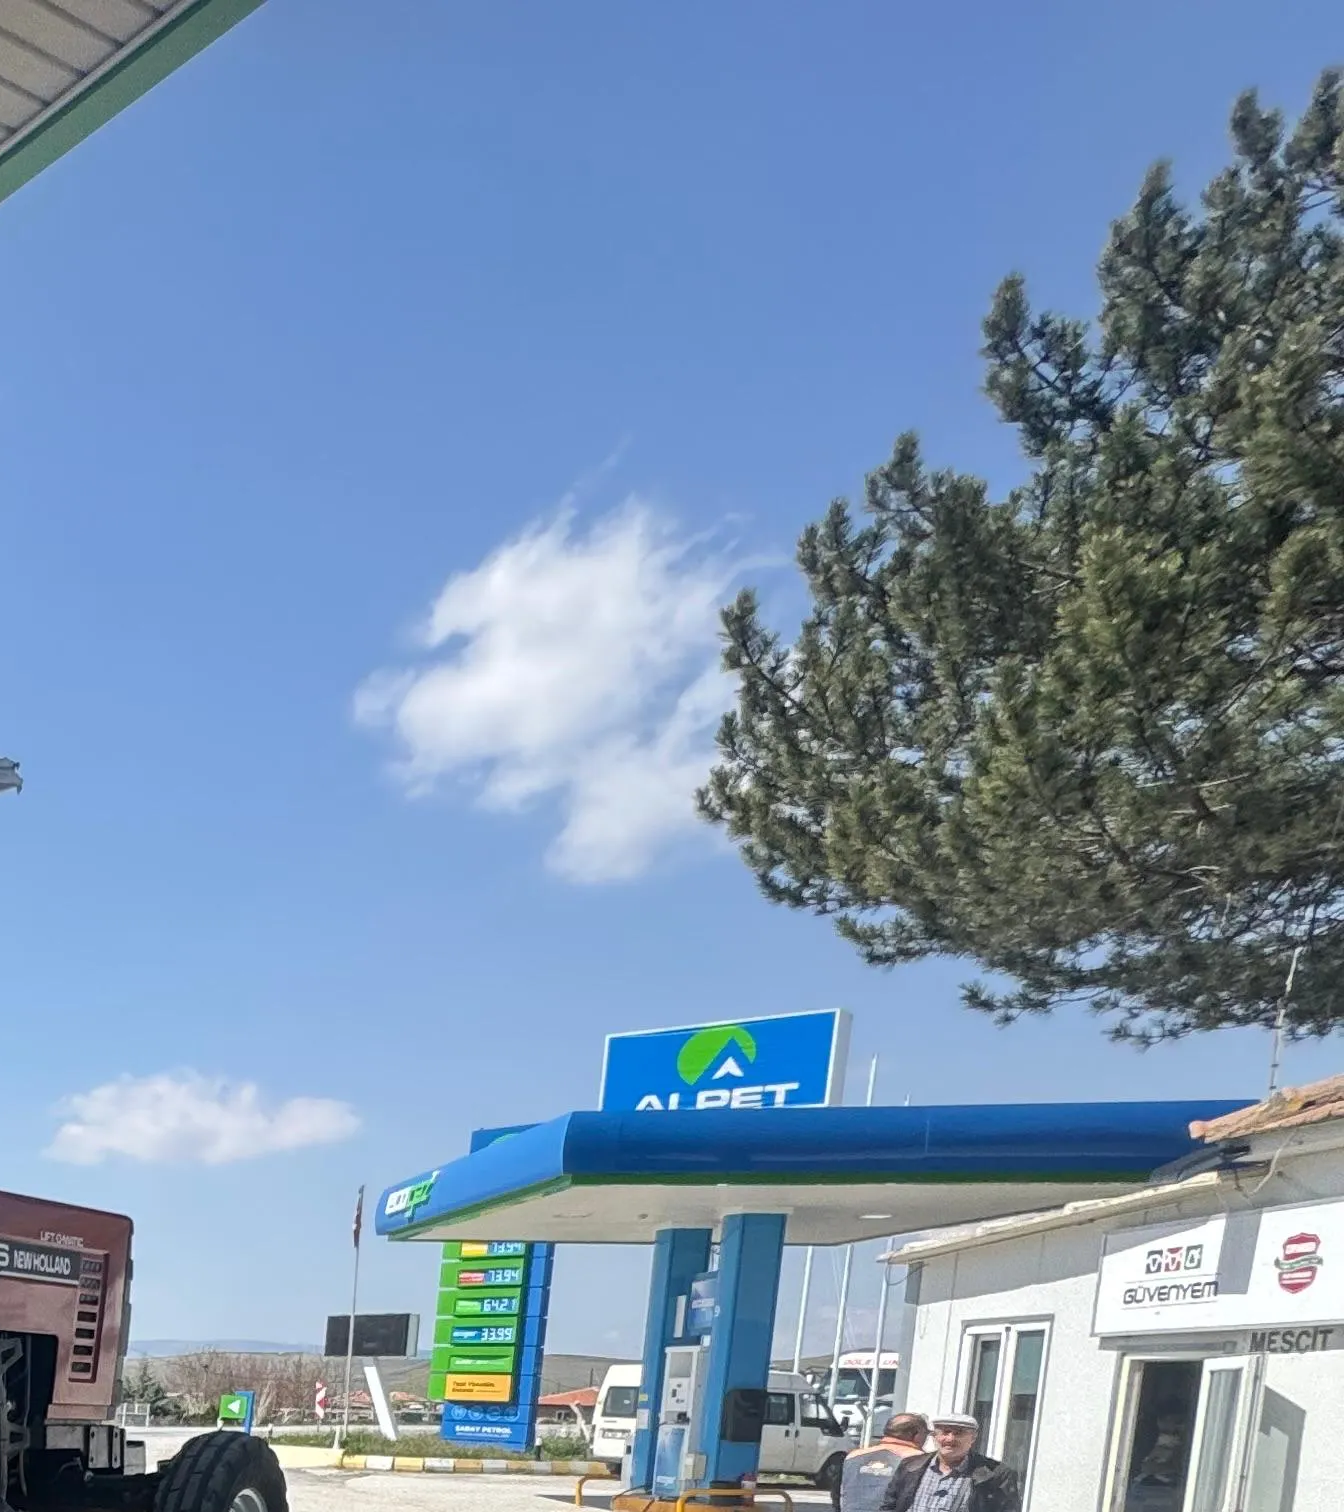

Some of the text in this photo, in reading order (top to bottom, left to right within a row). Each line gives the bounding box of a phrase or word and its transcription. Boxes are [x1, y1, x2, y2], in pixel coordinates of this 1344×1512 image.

[13, 1249, 34, 1270] NEW
[33, 1252, 71, 1276] HOLLAND
[1123, 1280, 1218, 1305] GÜVENYEM
